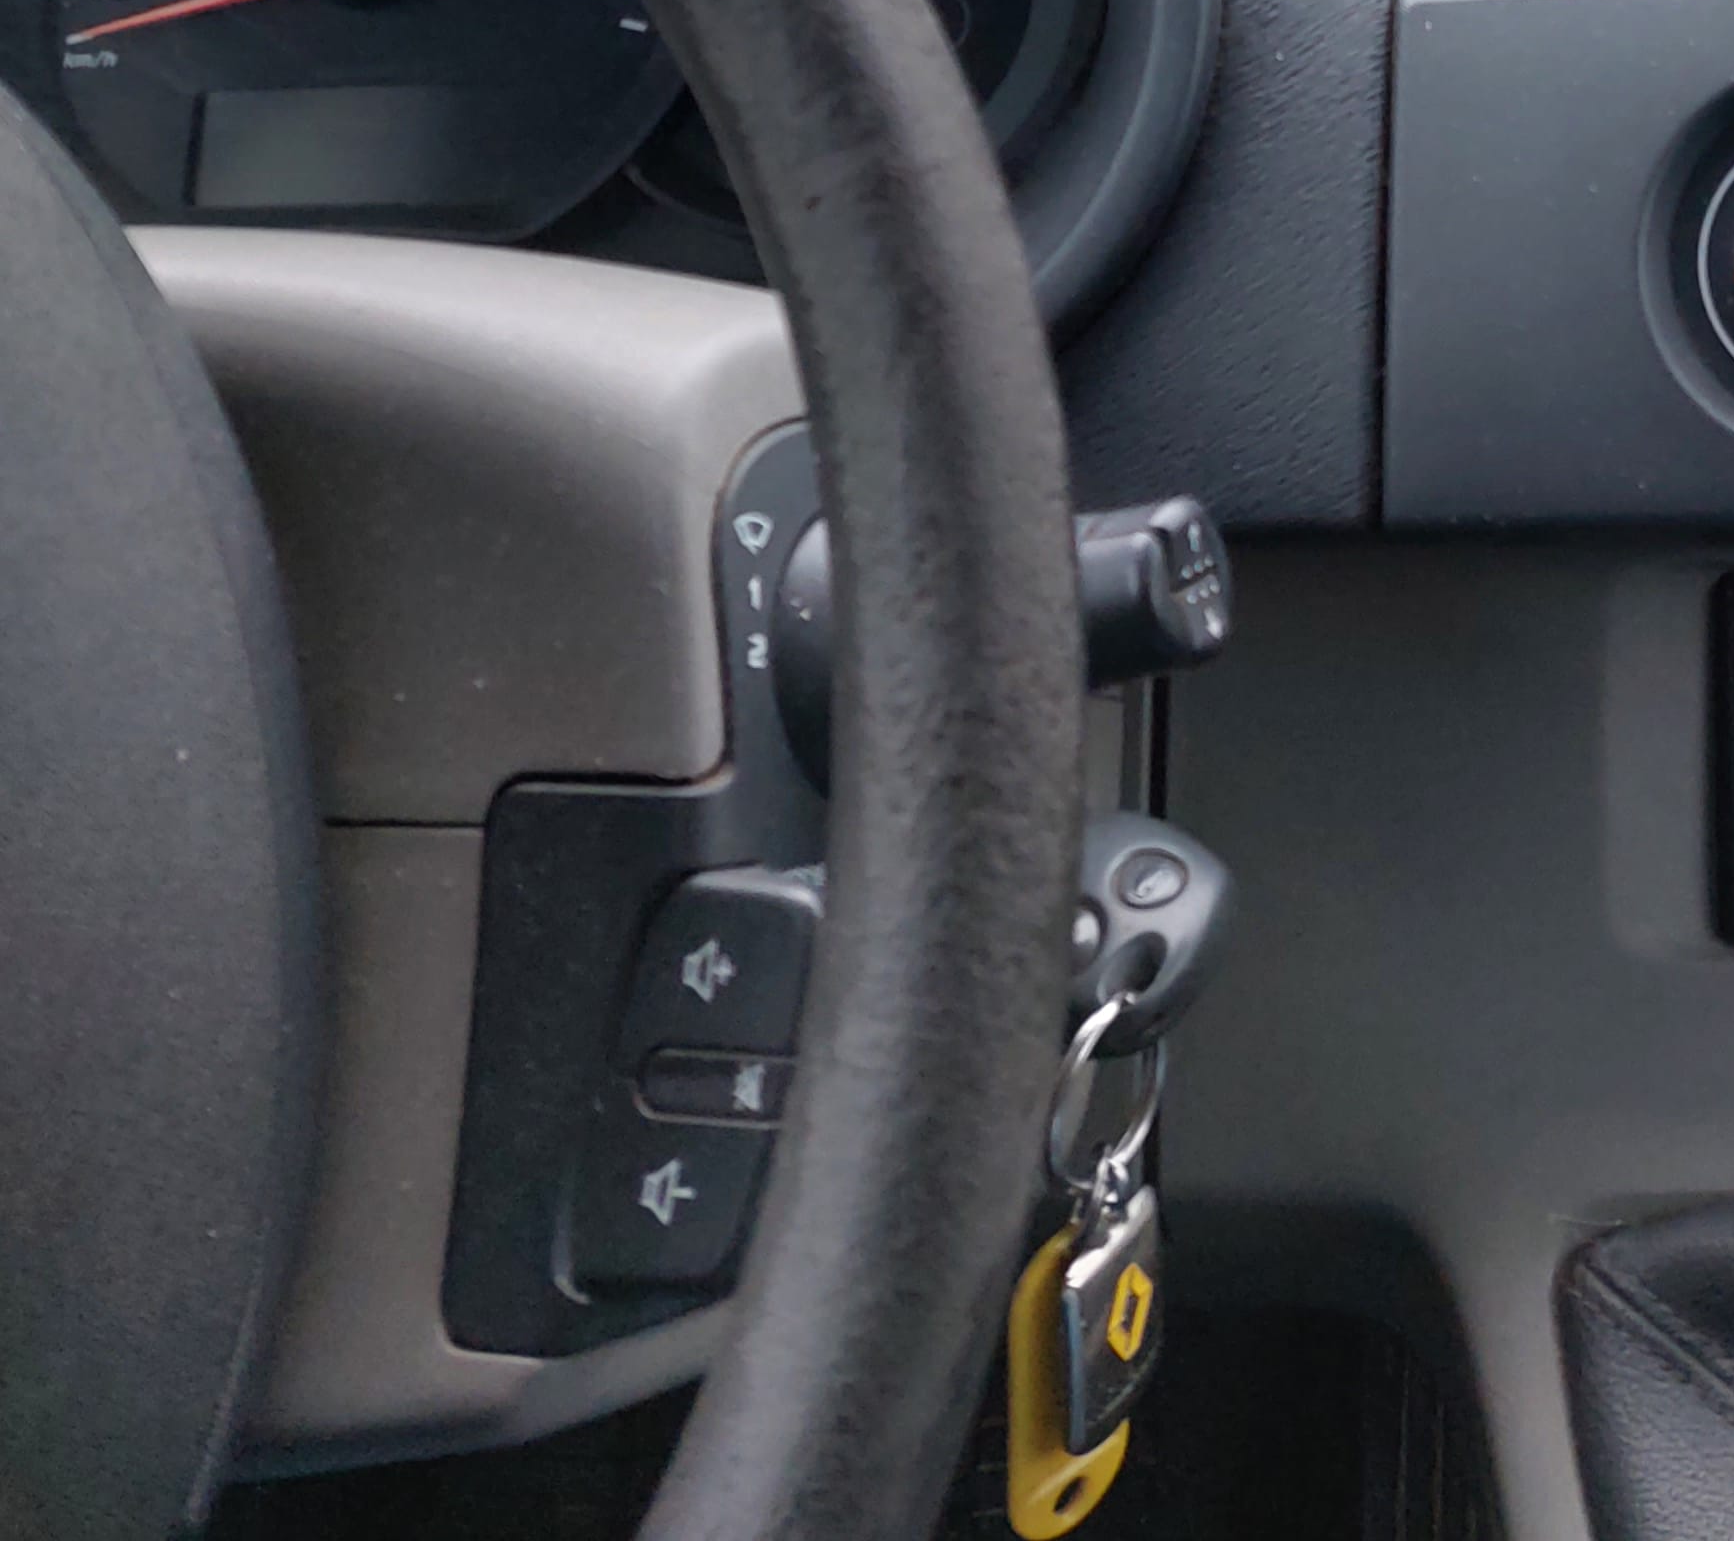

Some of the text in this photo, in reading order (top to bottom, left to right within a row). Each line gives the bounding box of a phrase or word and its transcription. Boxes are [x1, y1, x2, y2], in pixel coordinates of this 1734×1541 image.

[63, 51, 118, 69] km/h
[748, 574, 763, 611] 1
[747, 632, 769, 669] 2
